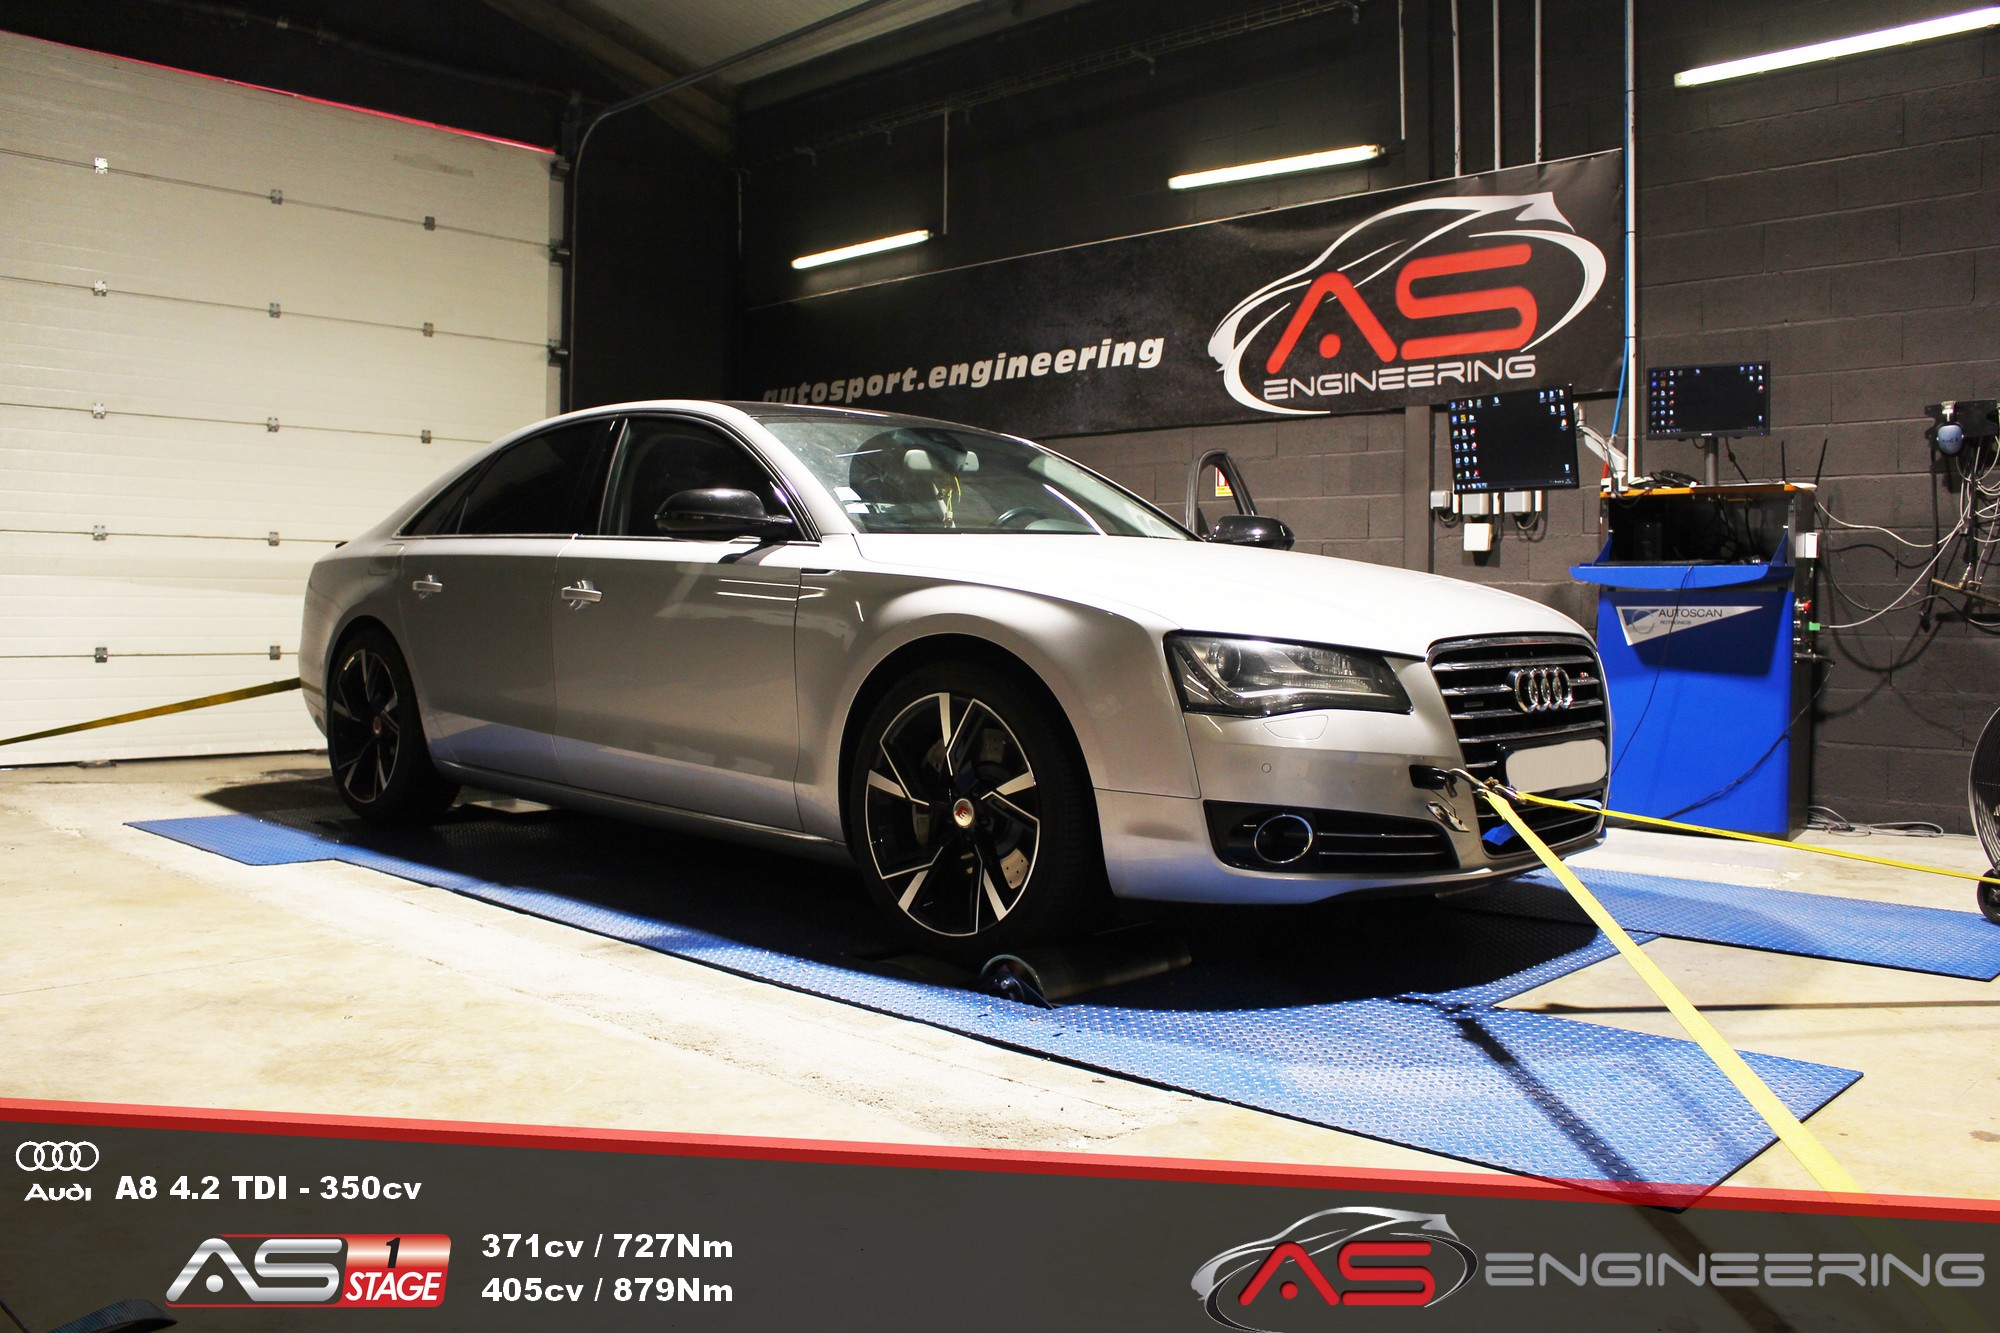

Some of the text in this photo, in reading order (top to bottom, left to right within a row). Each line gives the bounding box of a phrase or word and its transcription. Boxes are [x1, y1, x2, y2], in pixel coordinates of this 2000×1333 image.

[1265, 242, 1539, 375] AS
[1263, 354, 1537, 401] ENGINEERING
[1658, 608, 1723, 618] AUTOSCAN
